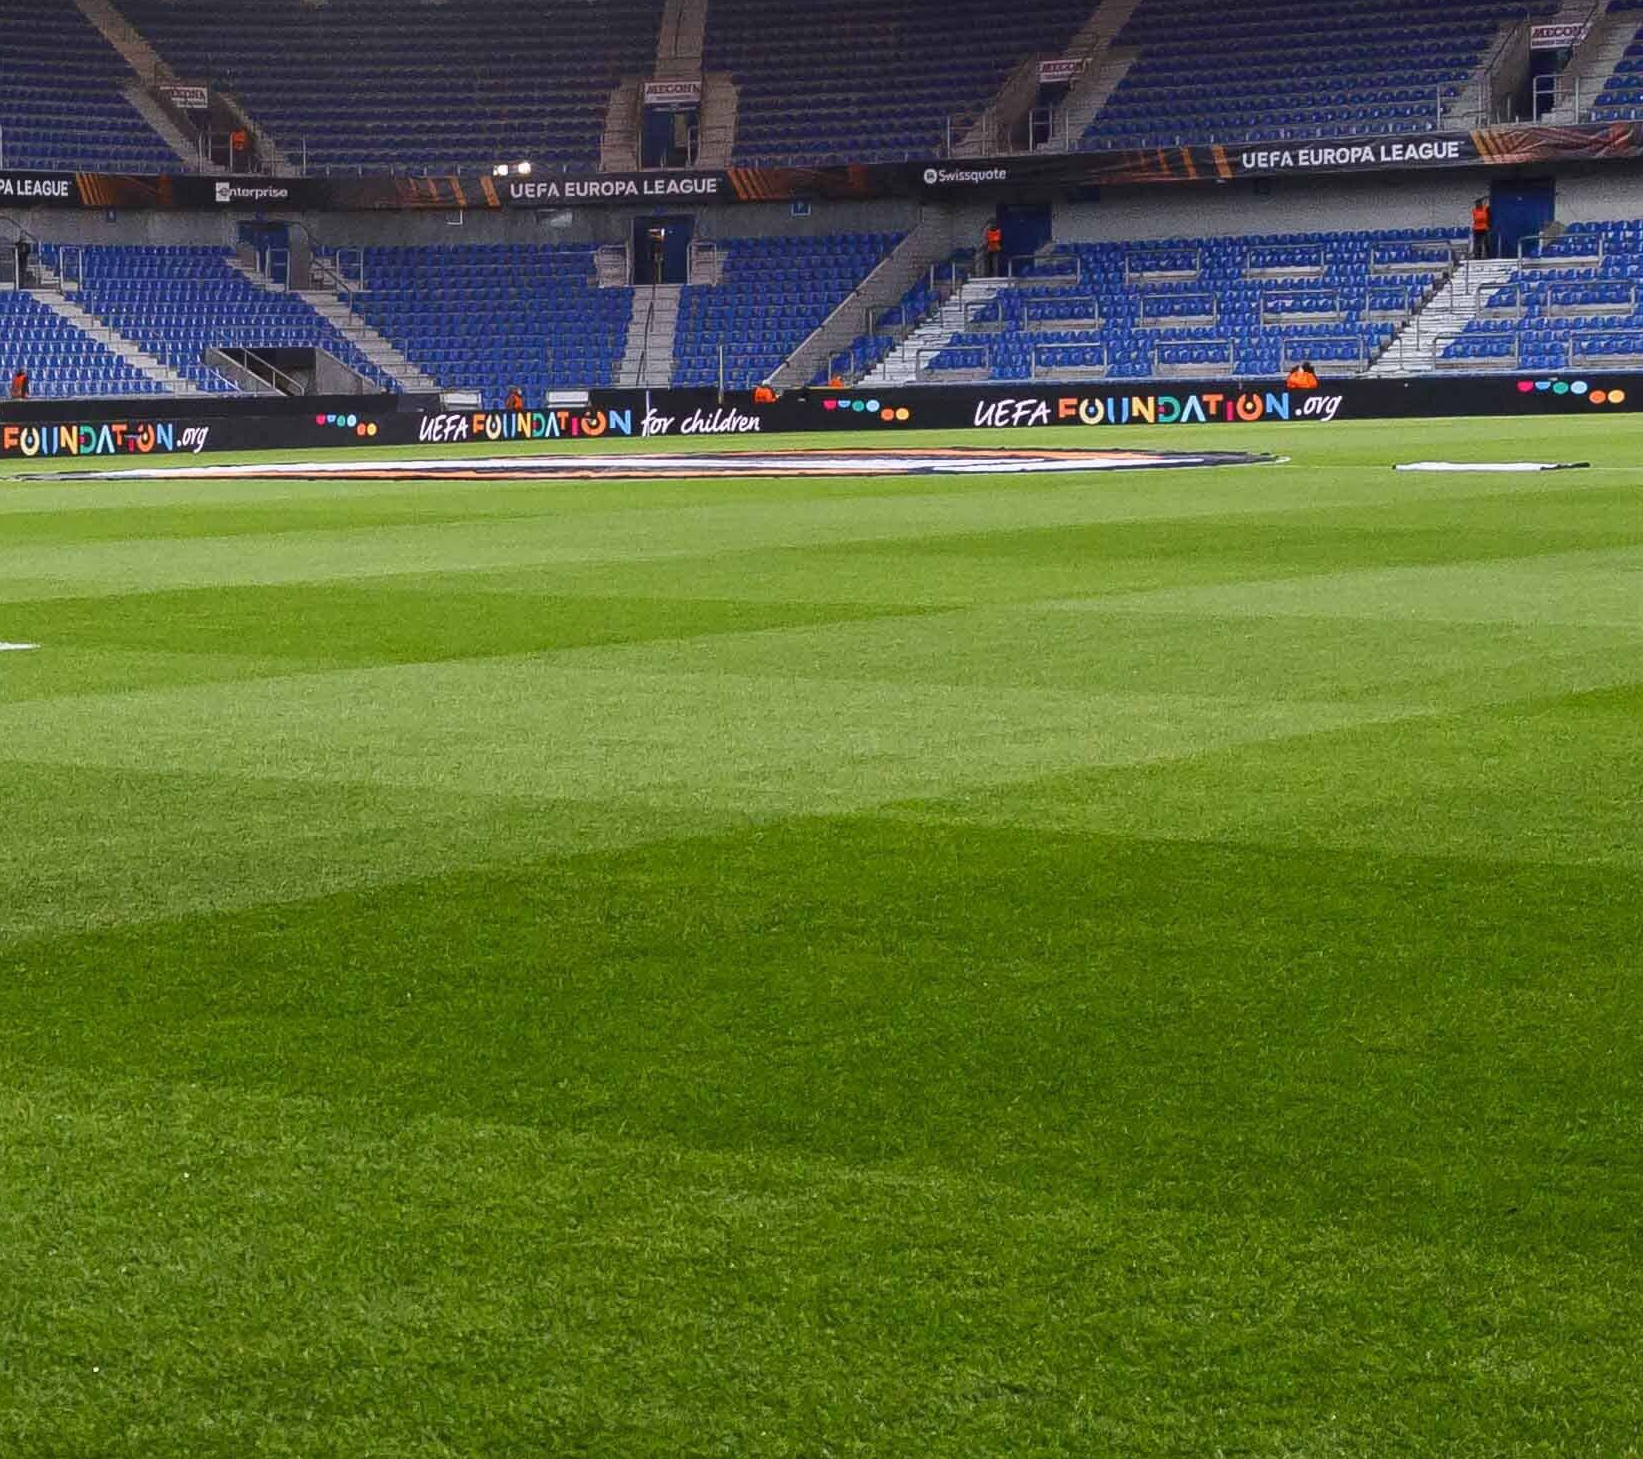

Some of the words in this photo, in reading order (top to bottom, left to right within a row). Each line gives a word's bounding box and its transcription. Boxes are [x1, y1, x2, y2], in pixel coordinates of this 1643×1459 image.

[1242, 151, 1293, 169] UEFA
[1298, 147, 1376, 166] EUROPA
[1379, 141, 1460, 156] LEAGUE
[16, 179, 69, 196] LEAGUE
[510, 182, 560, 198] UEFA
[564, 180, 638, 197] EUROPA
[643, 178, 718, 195] LEAGUE
[938, 168, 1007, 184] Swissquote
[973, 398, 1052, 427] UEFA
[1058, 393, 1289, 425] FOUNDATION
[1295, 395, 1343, 422] .org
[419, 415, 468, 441] UEFA
[473, 410, 631, 440] FOUNDATION
[641, 408, 675, 437] for
[681, 408, 760, 434] children
[177, 427, 209, 454] .org
